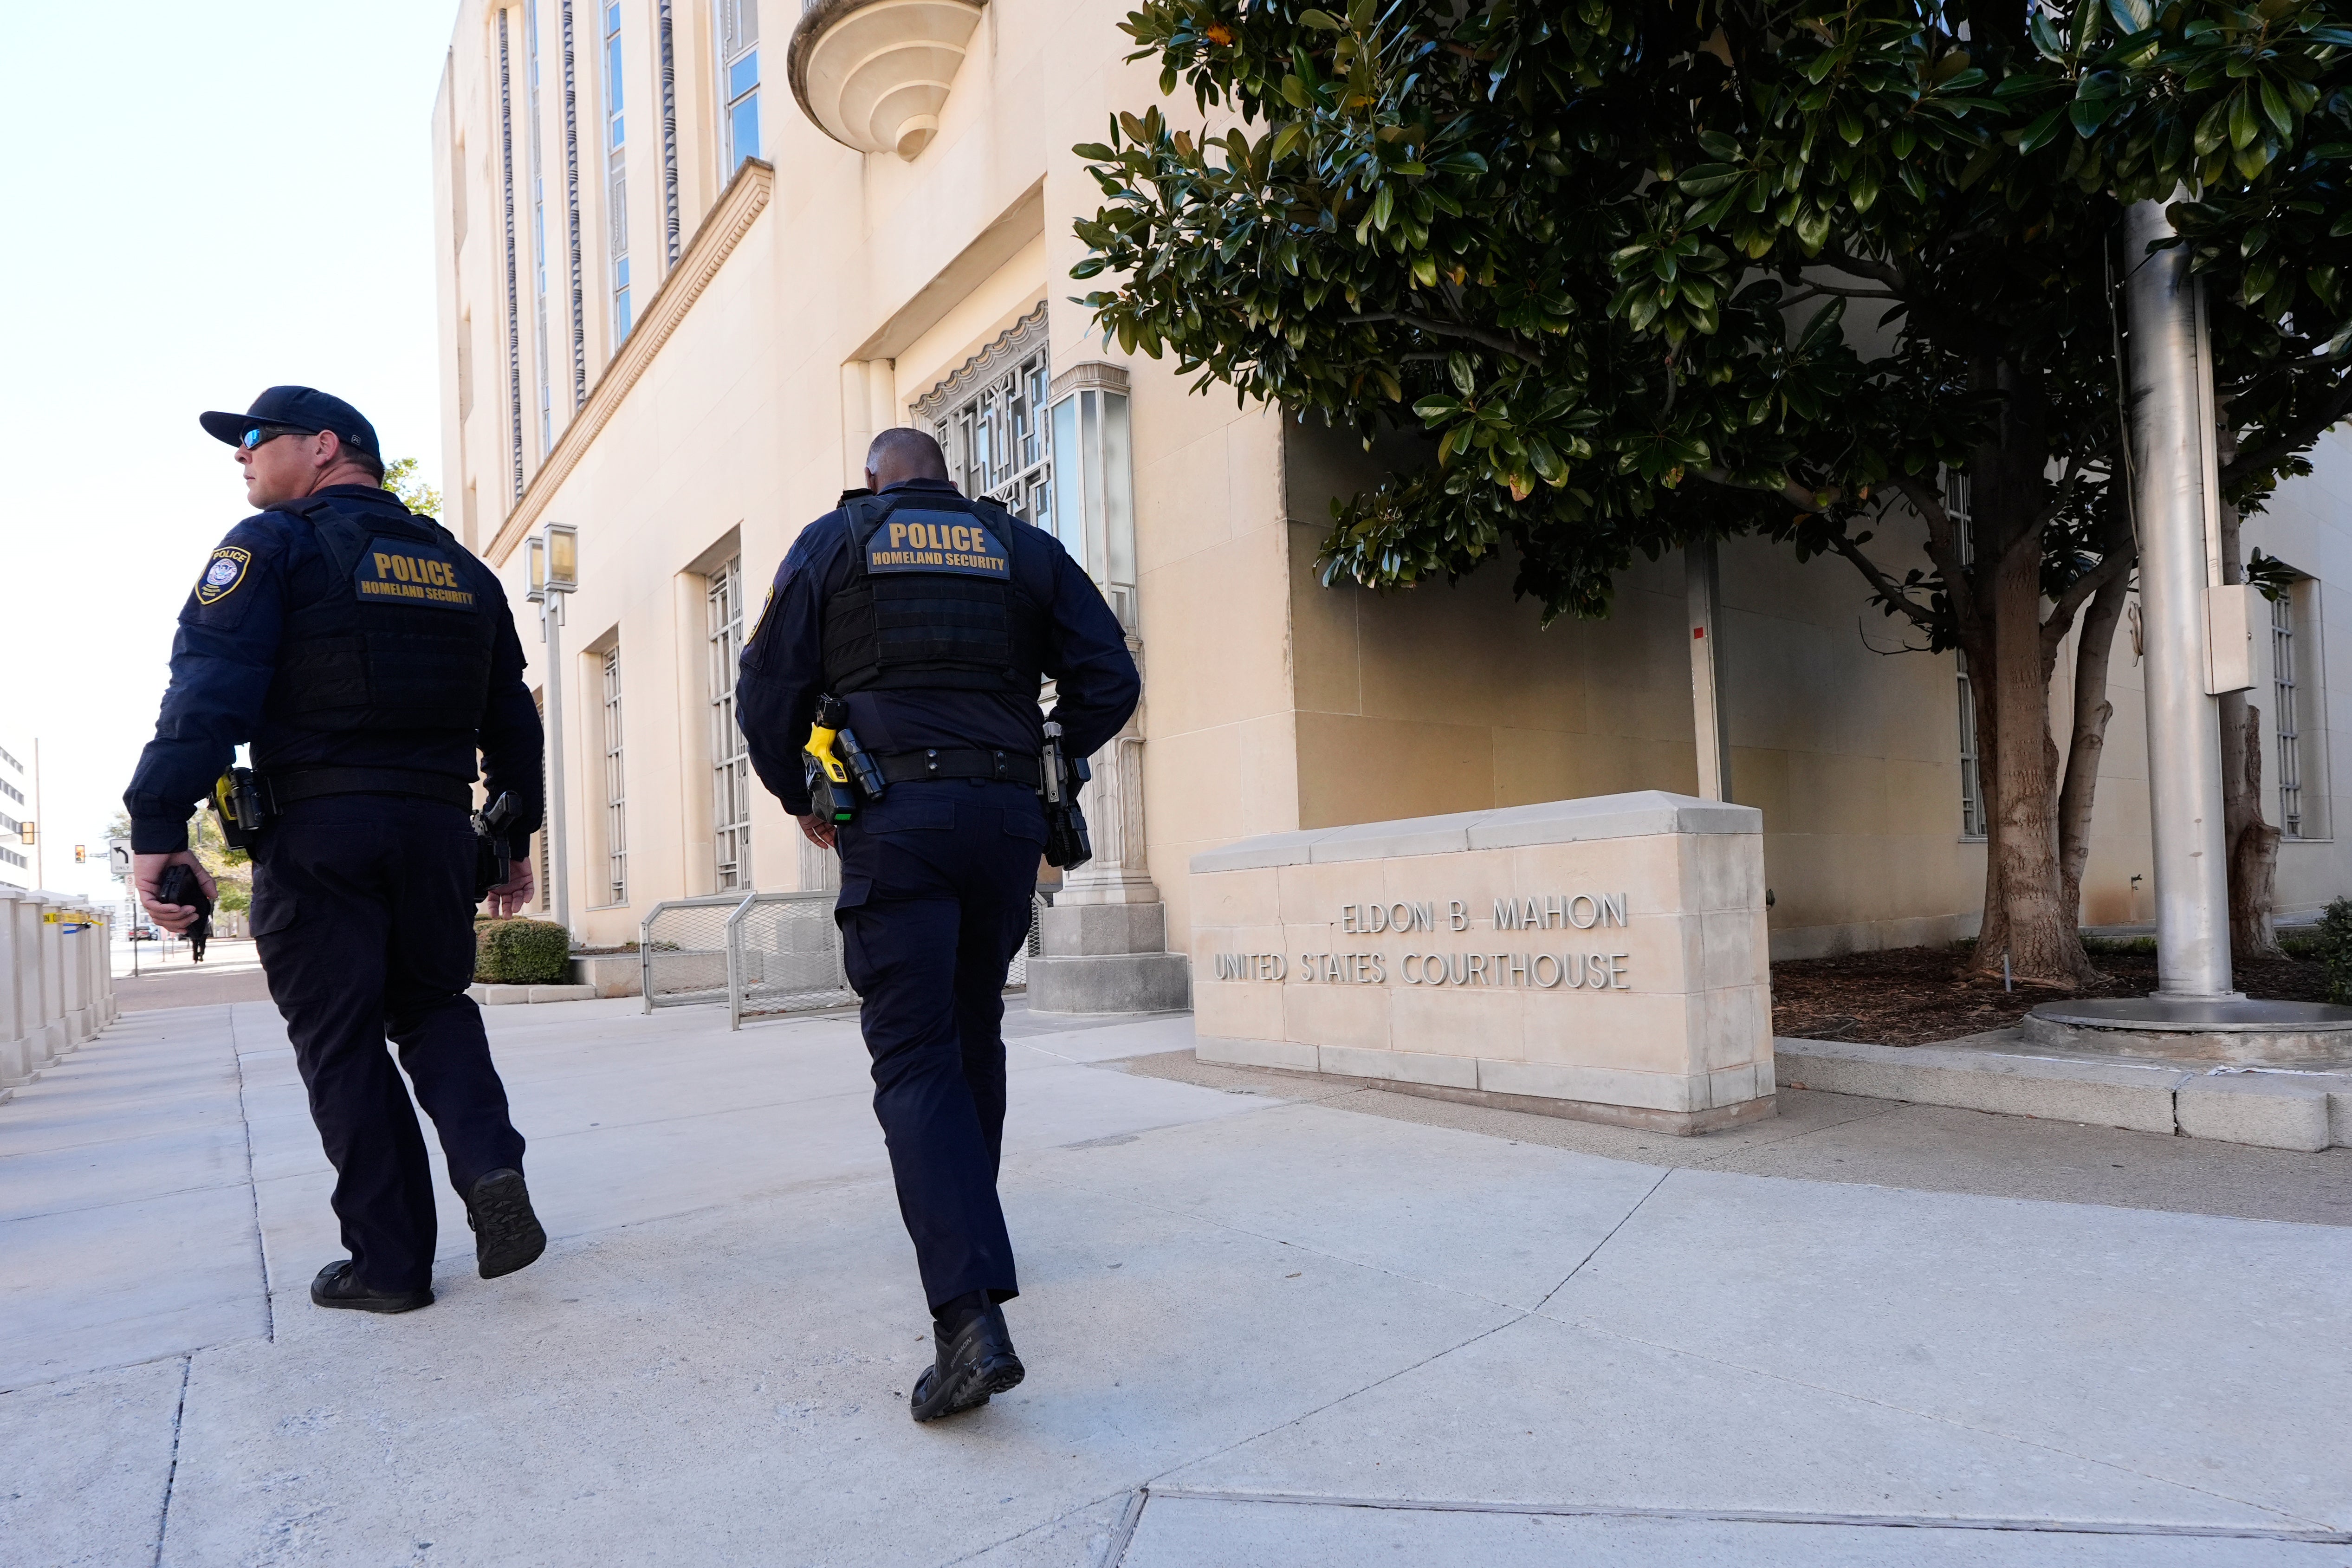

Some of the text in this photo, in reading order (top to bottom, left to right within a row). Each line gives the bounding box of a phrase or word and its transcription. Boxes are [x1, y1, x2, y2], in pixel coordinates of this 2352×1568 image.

[889, 523, 986, 553] POLICE
[213, 550, 248, 563] POLICE
[373, 552, 458, 588] POLICE
[872, 551, 1004, 571] HOMELAND SECURITY
[361, 580, 473, 605] HOMELAND SECURITY
[1341, 892, 1627, 934] ELDON B MAHON
[1213, 952, 1631, 989] UNITED STATES COURTHOUSE
[950, 1336, 972, 1370] SALOMON
